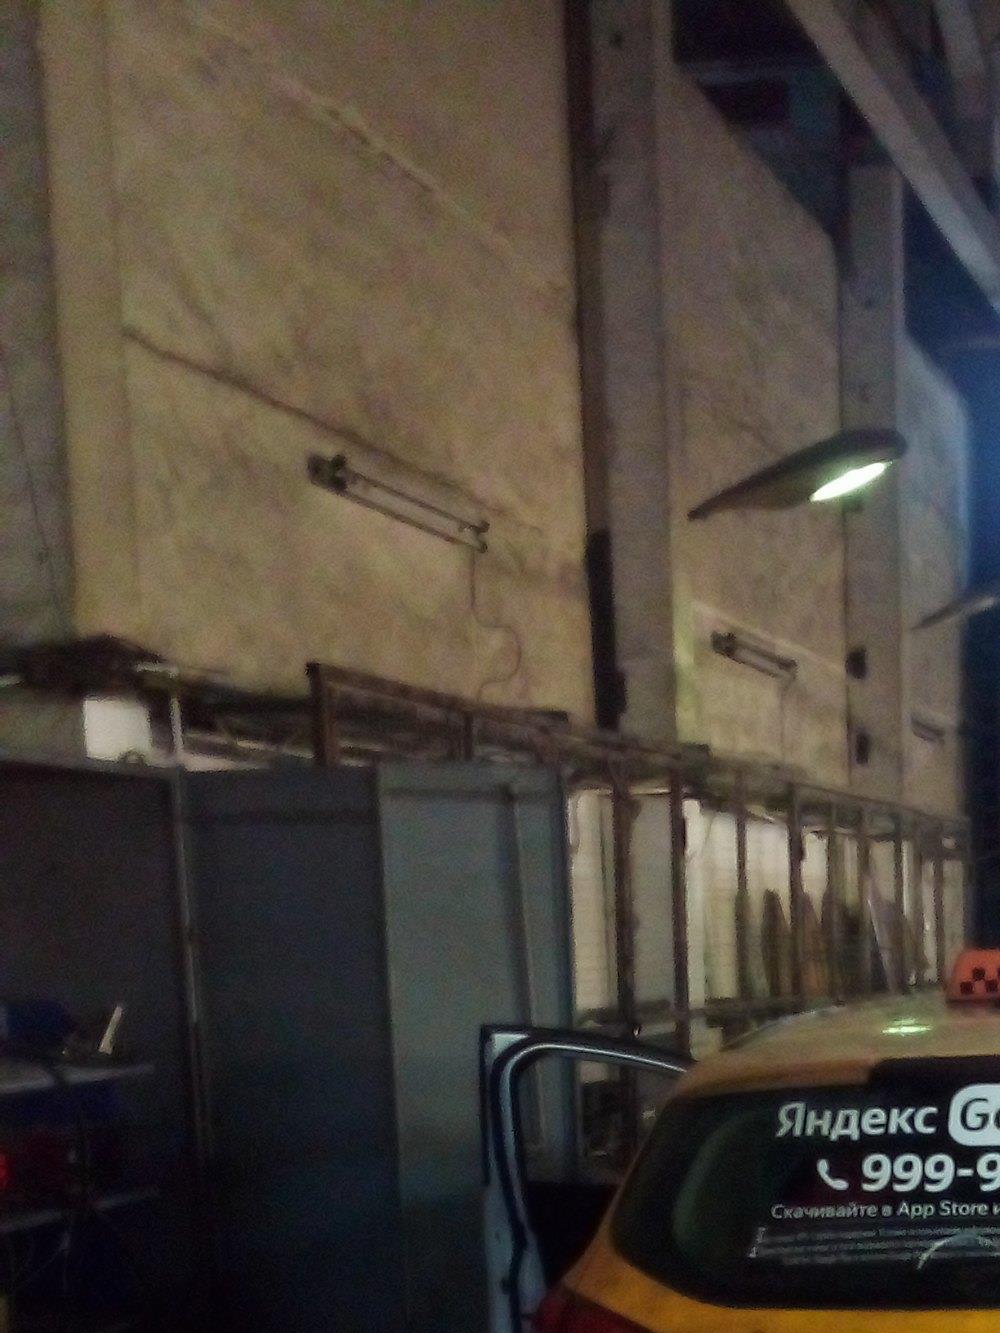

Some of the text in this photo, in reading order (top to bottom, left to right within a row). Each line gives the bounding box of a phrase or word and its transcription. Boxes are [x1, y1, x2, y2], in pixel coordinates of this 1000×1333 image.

[776, 1102, 938, 1142] Яндекс
[770, 1202, 877, 1220] Скачивайте
[881, 1206, 892, 1217] в
[899, 1203, 934, 1220] App
[939, 1201, 988, 1217] Store
